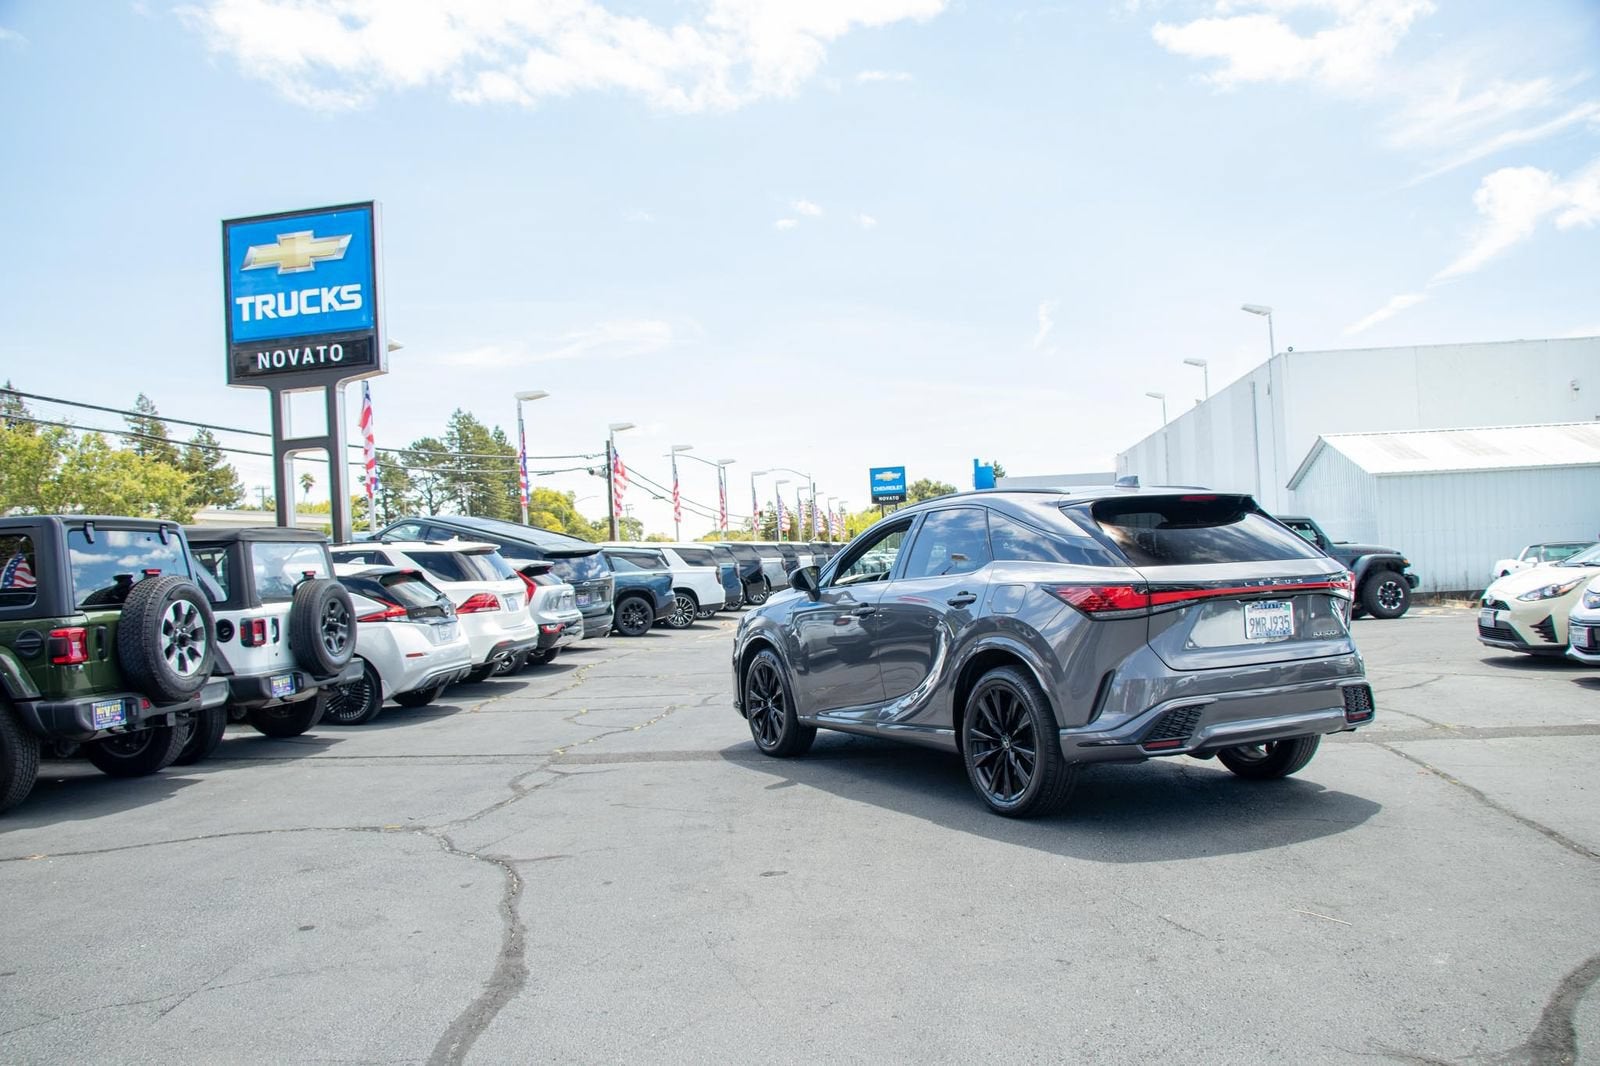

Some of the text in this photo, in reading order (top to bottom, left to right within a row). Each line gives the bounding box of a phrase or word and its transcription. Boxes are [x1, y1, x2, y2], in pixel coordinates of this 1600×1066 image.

[236, 284, 362, 321] TRUCKS
[257, 343, 343, 369] NOVATO
[1244, 578, 1303, 587] LEXUS
[1249, 615, 1290, 632] 9MRJ935
